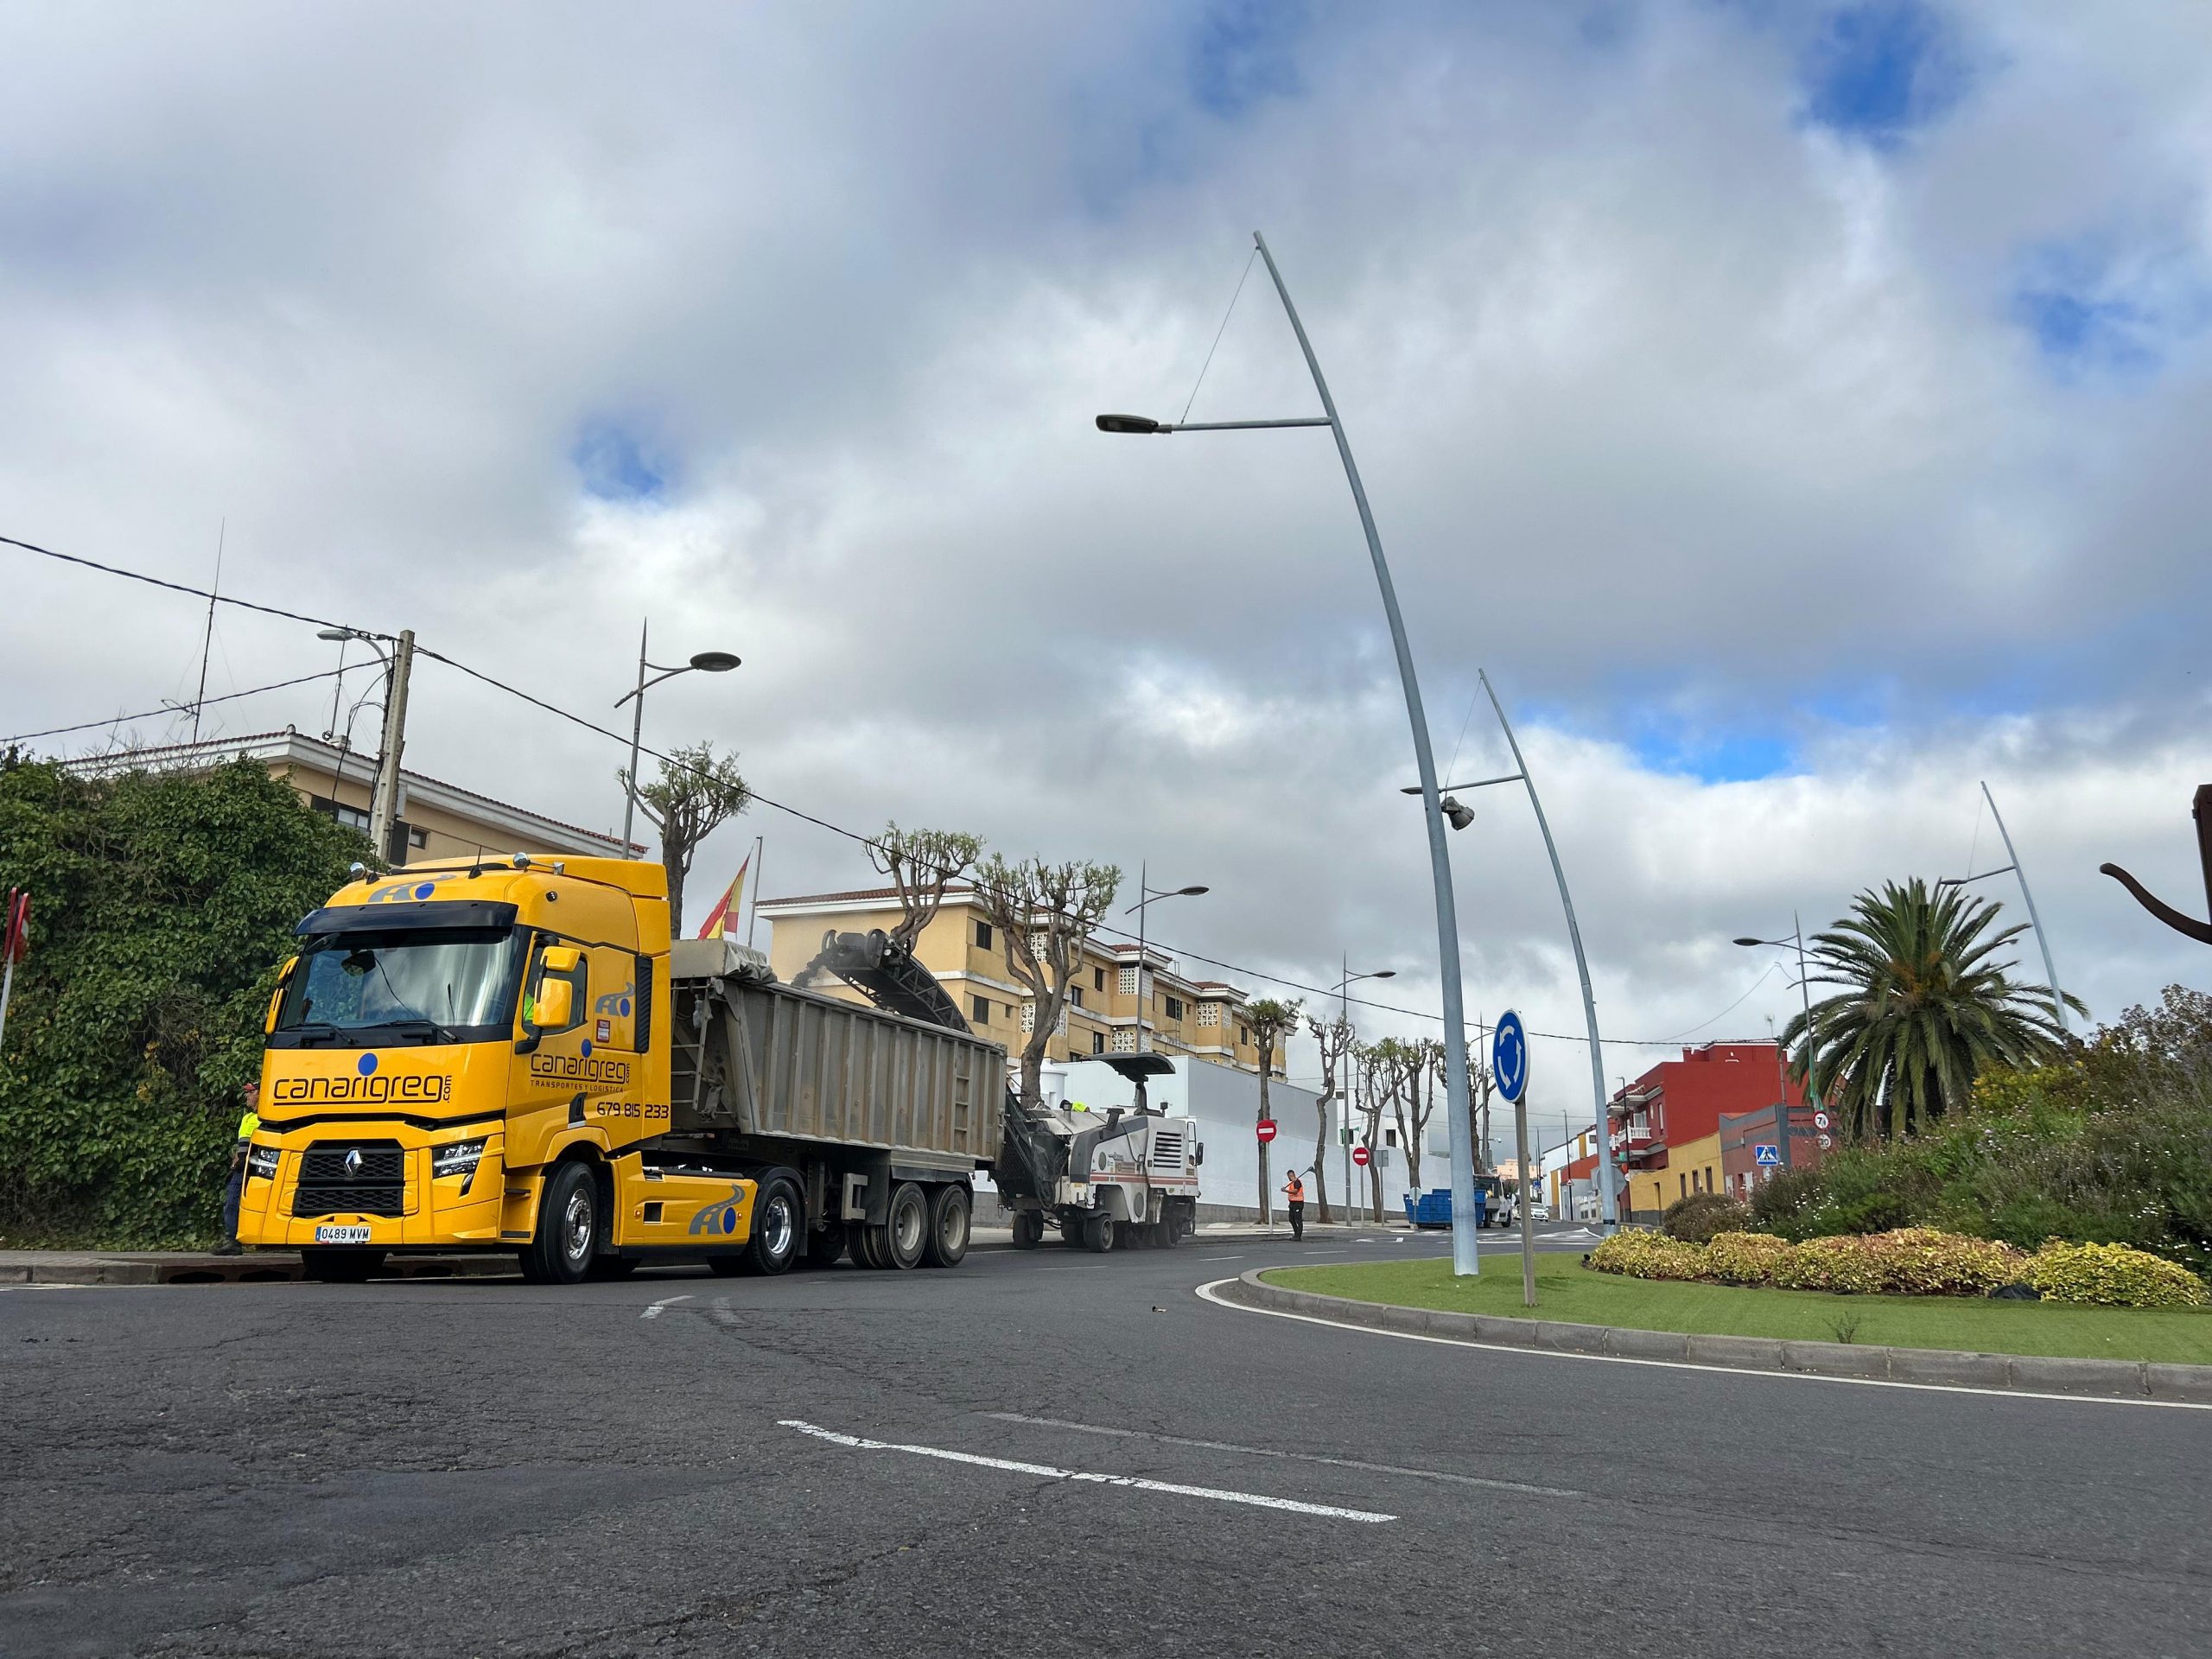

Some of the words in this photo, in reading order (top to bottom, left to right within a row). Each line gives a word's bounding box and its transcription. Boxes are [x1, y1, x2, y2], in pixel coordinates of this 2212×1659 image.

[531, 1039, 626, 1085] canarigreg
[273, 1052, 443, 1106] canarigreg
[531, 1080, 582, 1090] TRANSPORTES
[597, 1102, 621, 1116] 679
[624, 1103, 640, 1118] 815
[644, 1104, 670, 1119] 233
[321, 1228, 346, 1239] 0489
[350, 1228, 369, 1239] MVM
